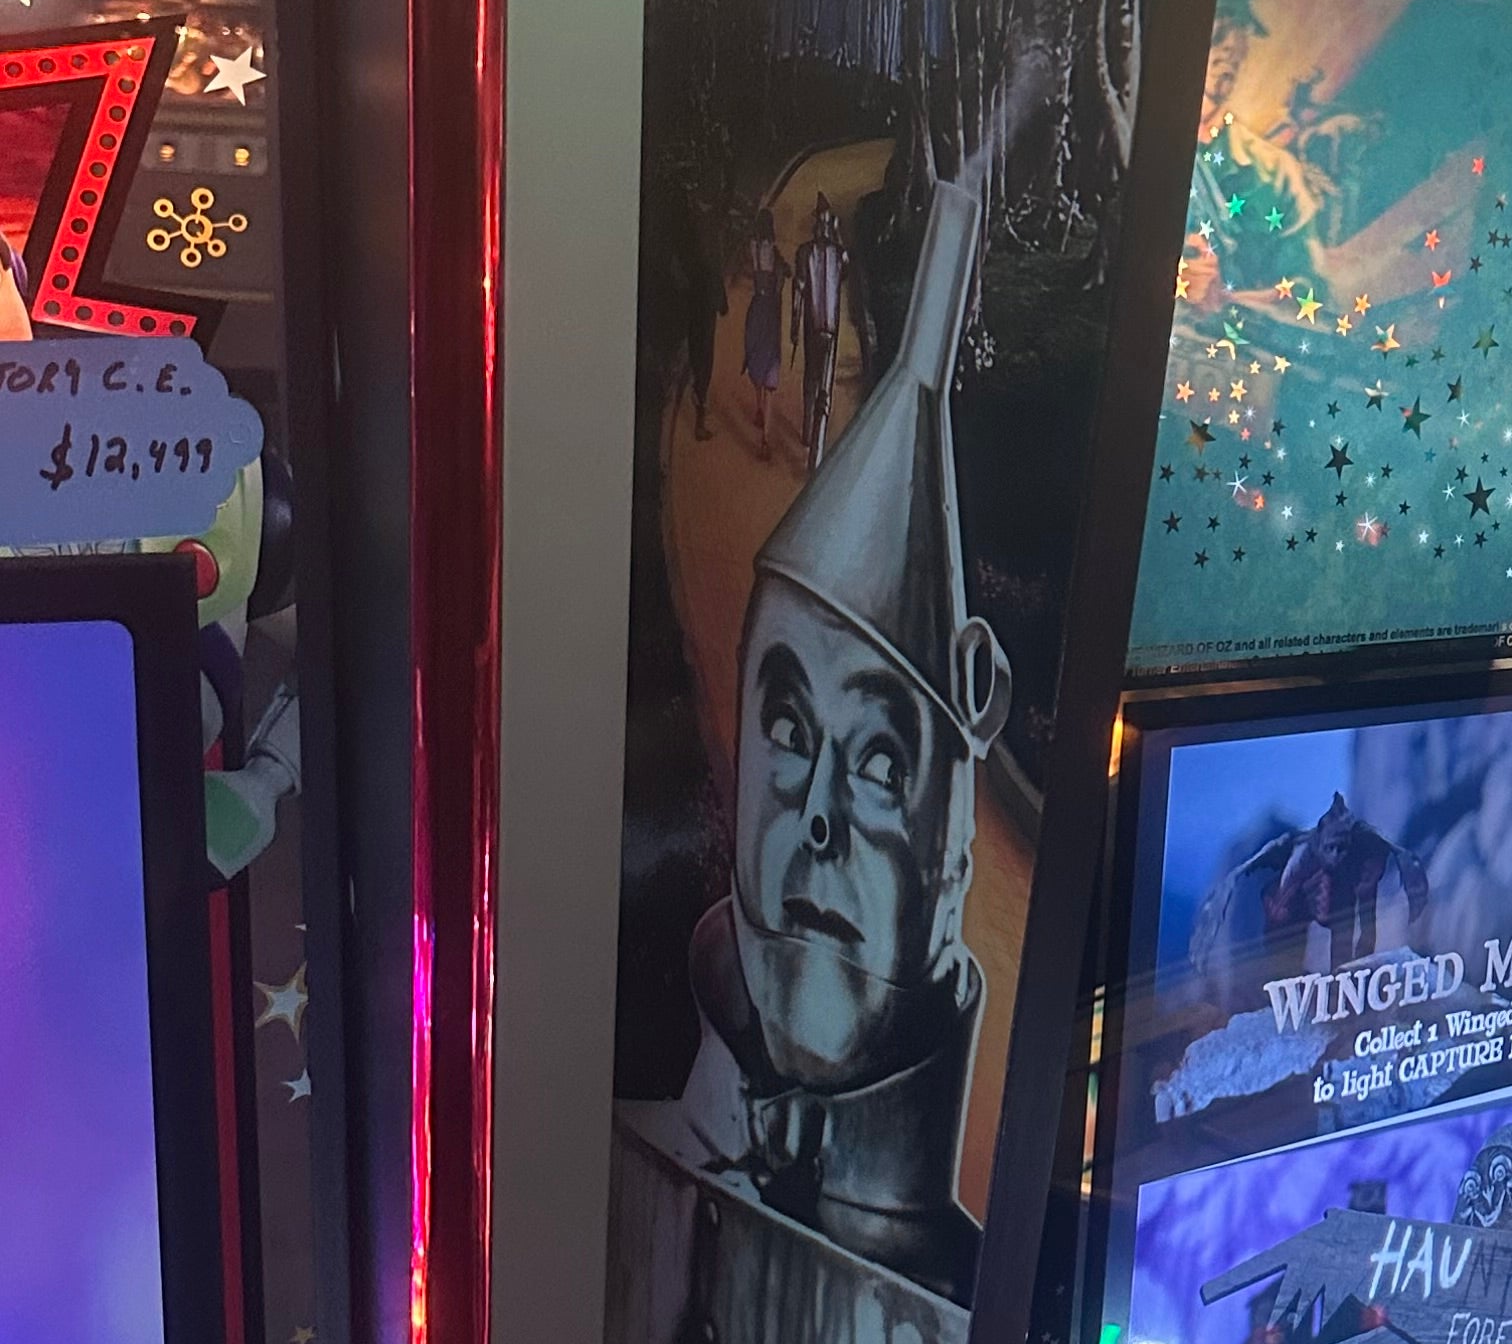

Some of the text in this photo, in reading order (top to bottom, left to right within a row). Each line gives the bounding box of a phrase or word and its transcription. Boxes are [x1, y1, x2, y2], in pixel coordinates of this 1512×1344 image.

[40, 422, 213, 491] $12,499
[1197, 641, 1214, 654] OF
[1216, 639, 1233, 653] OZ
[1234, 639, 1256, 651] and
[1258, 636, 1271, 650] all
[1274, 635, 1310, 649] related
[1313, 632, 1366, 646] characters
[1369, 628, 1388, 641] and
[1390, 625, 1434, 640] elements
[1437, 626, 1452, 637] are
[1263, 951, 1465, 1035] WINGED
[1313, 1075, 1335, 1104] to
[1341, 1062, 1394, 1102] light
[1399, 1037, 1503, 1084] CAPTURE
[1354, 1022, 1422, 1058] Collect
[1428, 1025, 1438, 1043] 1
